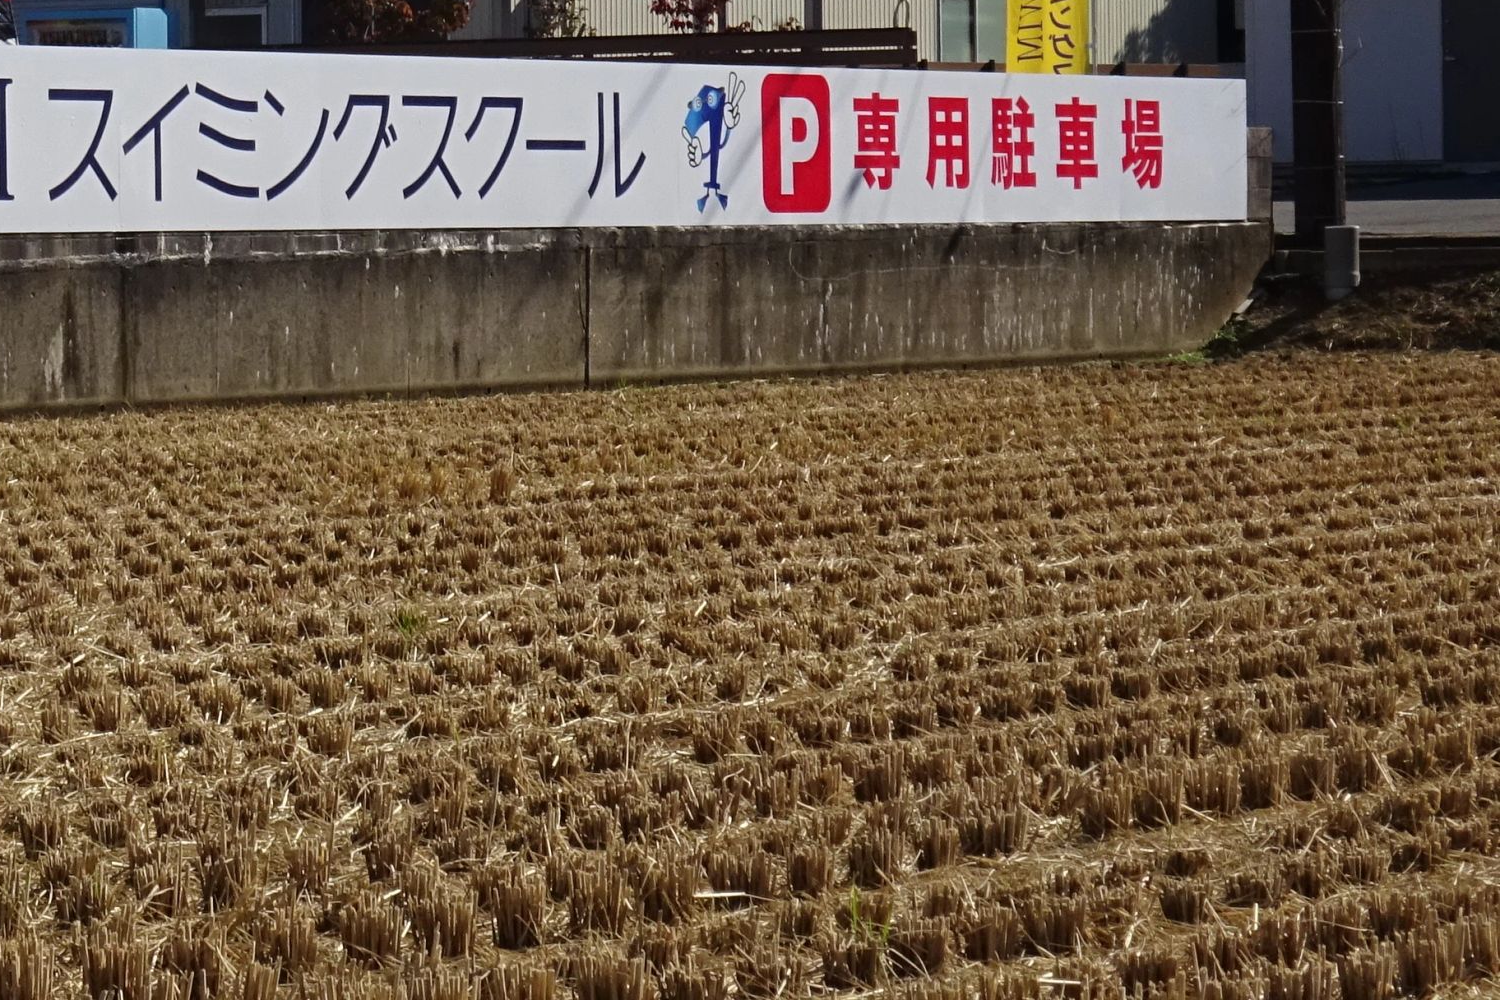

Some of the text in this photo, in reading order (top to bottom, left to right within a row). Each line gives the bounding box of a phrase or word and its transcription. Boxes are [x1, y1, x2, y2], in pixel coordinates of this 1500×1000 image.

[47, 81, 647, 201] スイミングスクール
[852, 92, 1164, 191] 専用駐車場
